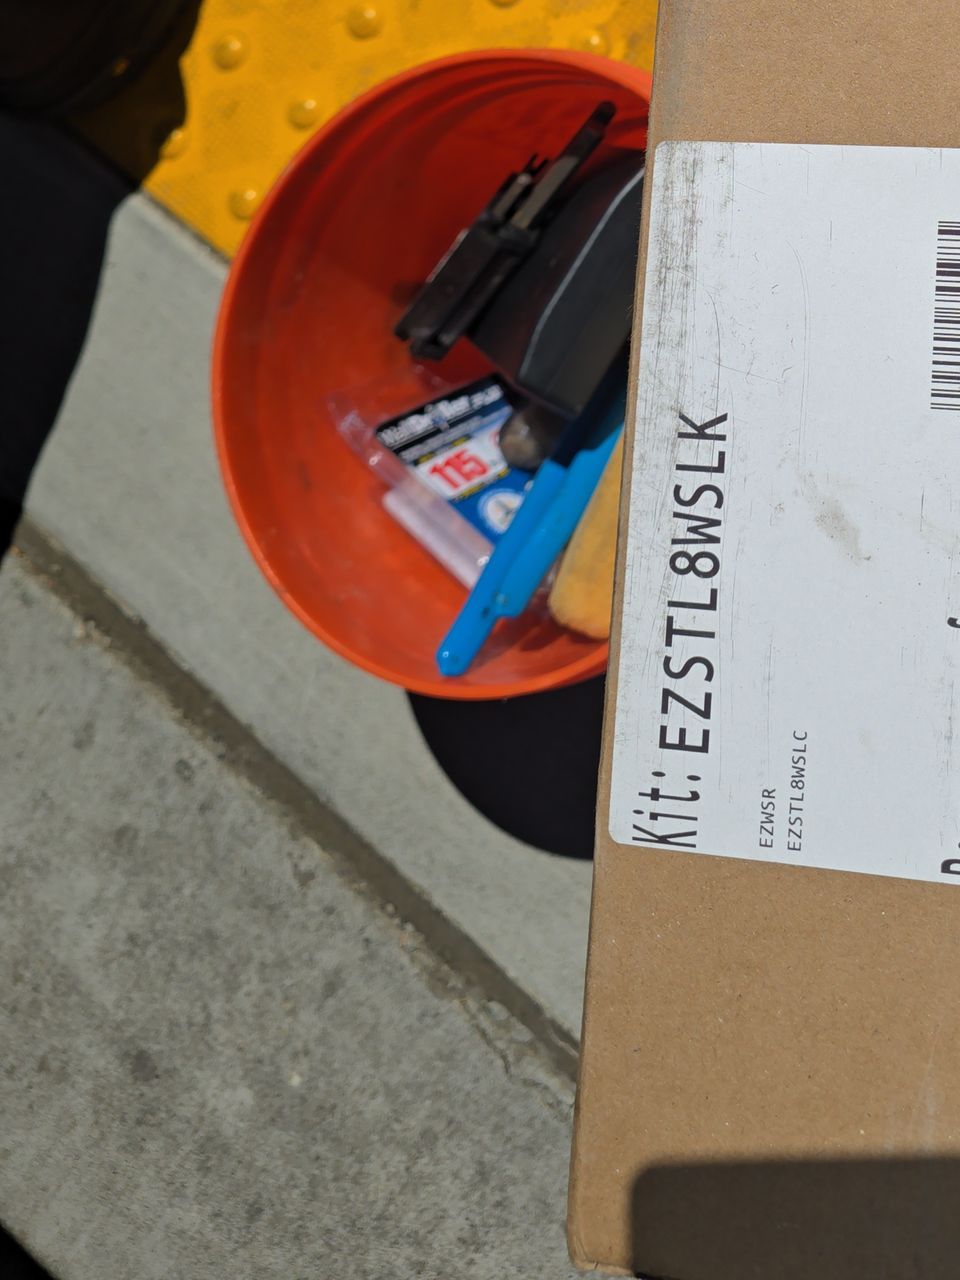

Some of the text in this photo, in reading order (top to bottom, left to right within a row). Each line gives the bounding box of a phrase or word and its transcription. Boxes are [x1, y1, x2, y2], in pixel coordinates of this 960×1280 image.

[631, 412, 728, 848] Kit: EZSTL8WSLK
[758, 787, 776, 848] EZWSR
[788, 730, 808, 852] EZSTL8WSLC
